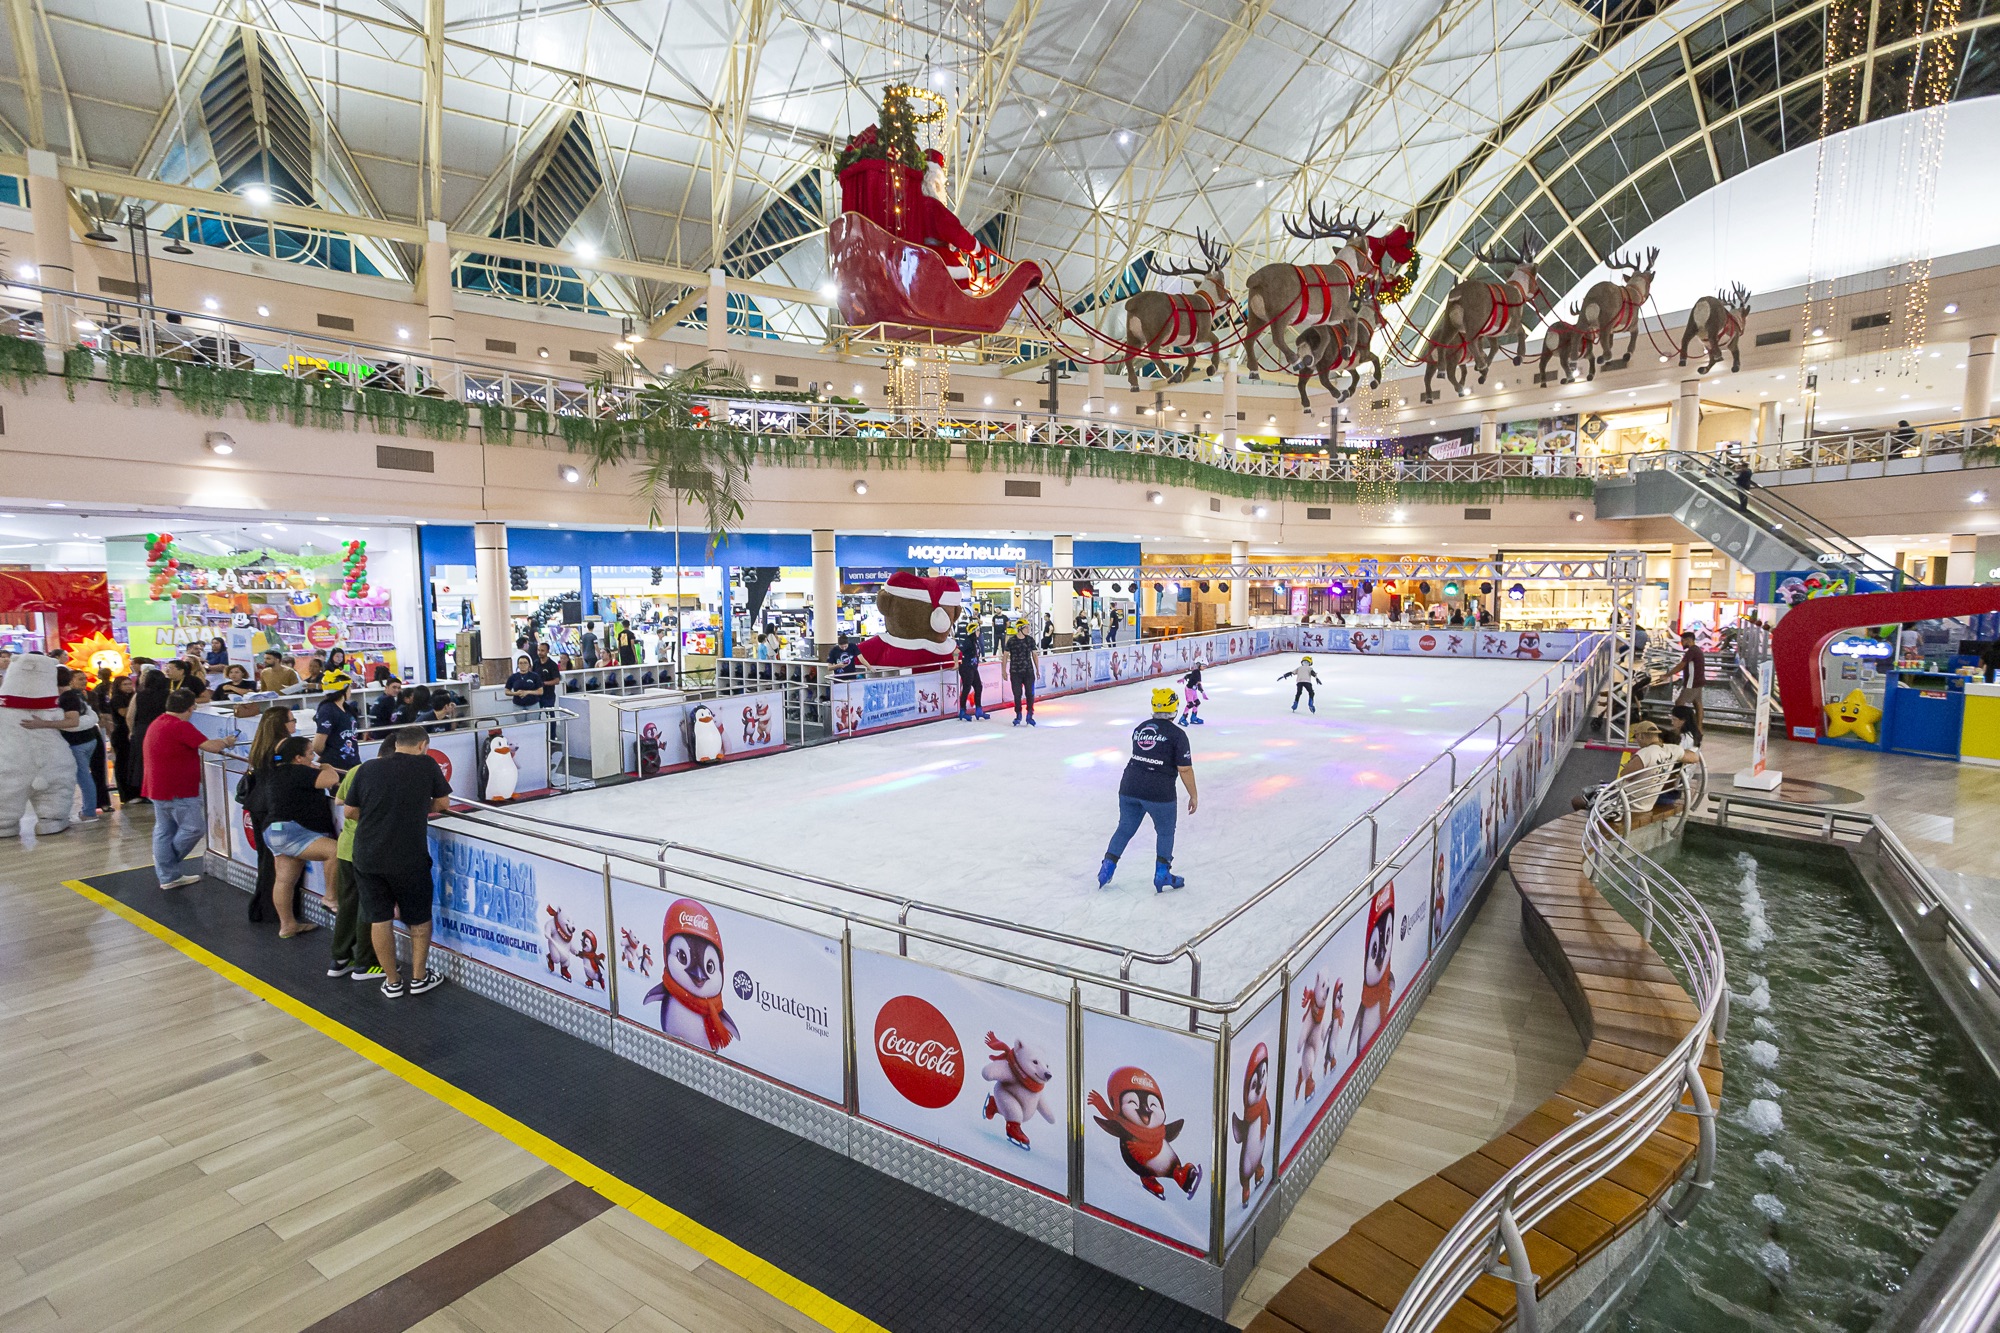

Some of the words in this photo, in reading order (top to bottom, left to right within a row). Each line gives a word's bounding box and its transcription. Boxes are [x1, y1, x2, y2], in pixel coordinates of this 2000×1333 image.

[474, 879, 539, 936] PARK
[442, 916, 458, 932] UMA
[460, 923, 495, 943] AVENTURA
[495, 933, 538, 955] CONGELANTE
[754, 981, 829, 1028] Iguatemi
[805, 1021, 830, 1038] Bosque
[878, 1027, 960, 1077] Coca-Cola
